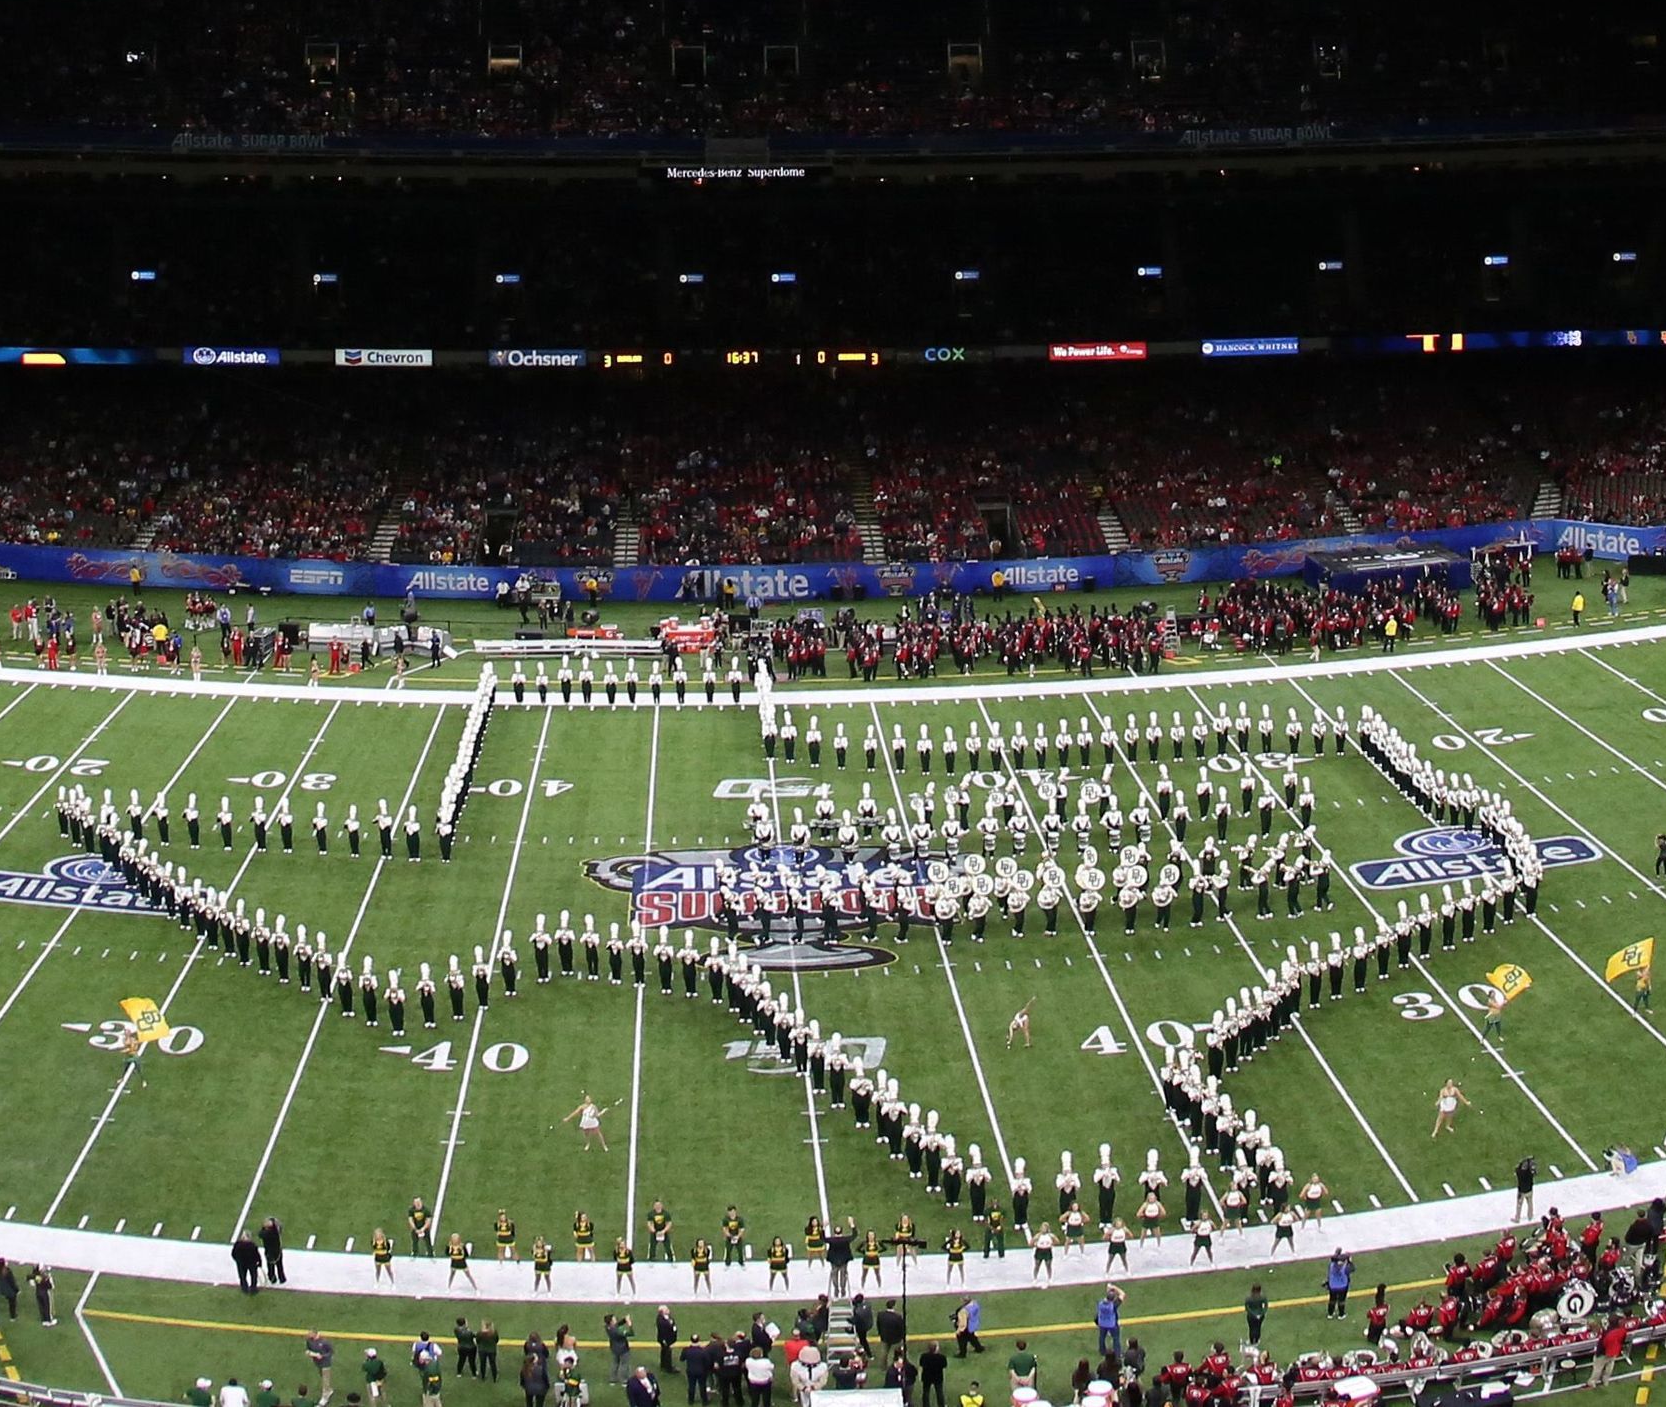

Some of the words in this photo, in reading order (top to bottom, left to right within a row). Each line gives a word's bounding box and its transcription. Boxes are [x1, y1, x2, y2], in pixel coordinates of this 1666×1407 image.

[925, 347, 965, 361] COX
[1216, 344, 1255, 352] HANCOCK
[1258, 342, 1299, 351] WHITNEY
[366, 351, 424, 365] Chevron
[508, 349, 579, 367] Ochsner
[727, 352, 759, 364] 16:37
[290, 570, 343, 585] ESPN
[1080, 1019, 1196, 1056] 40
[412, 1041, 530, 1074] 40
